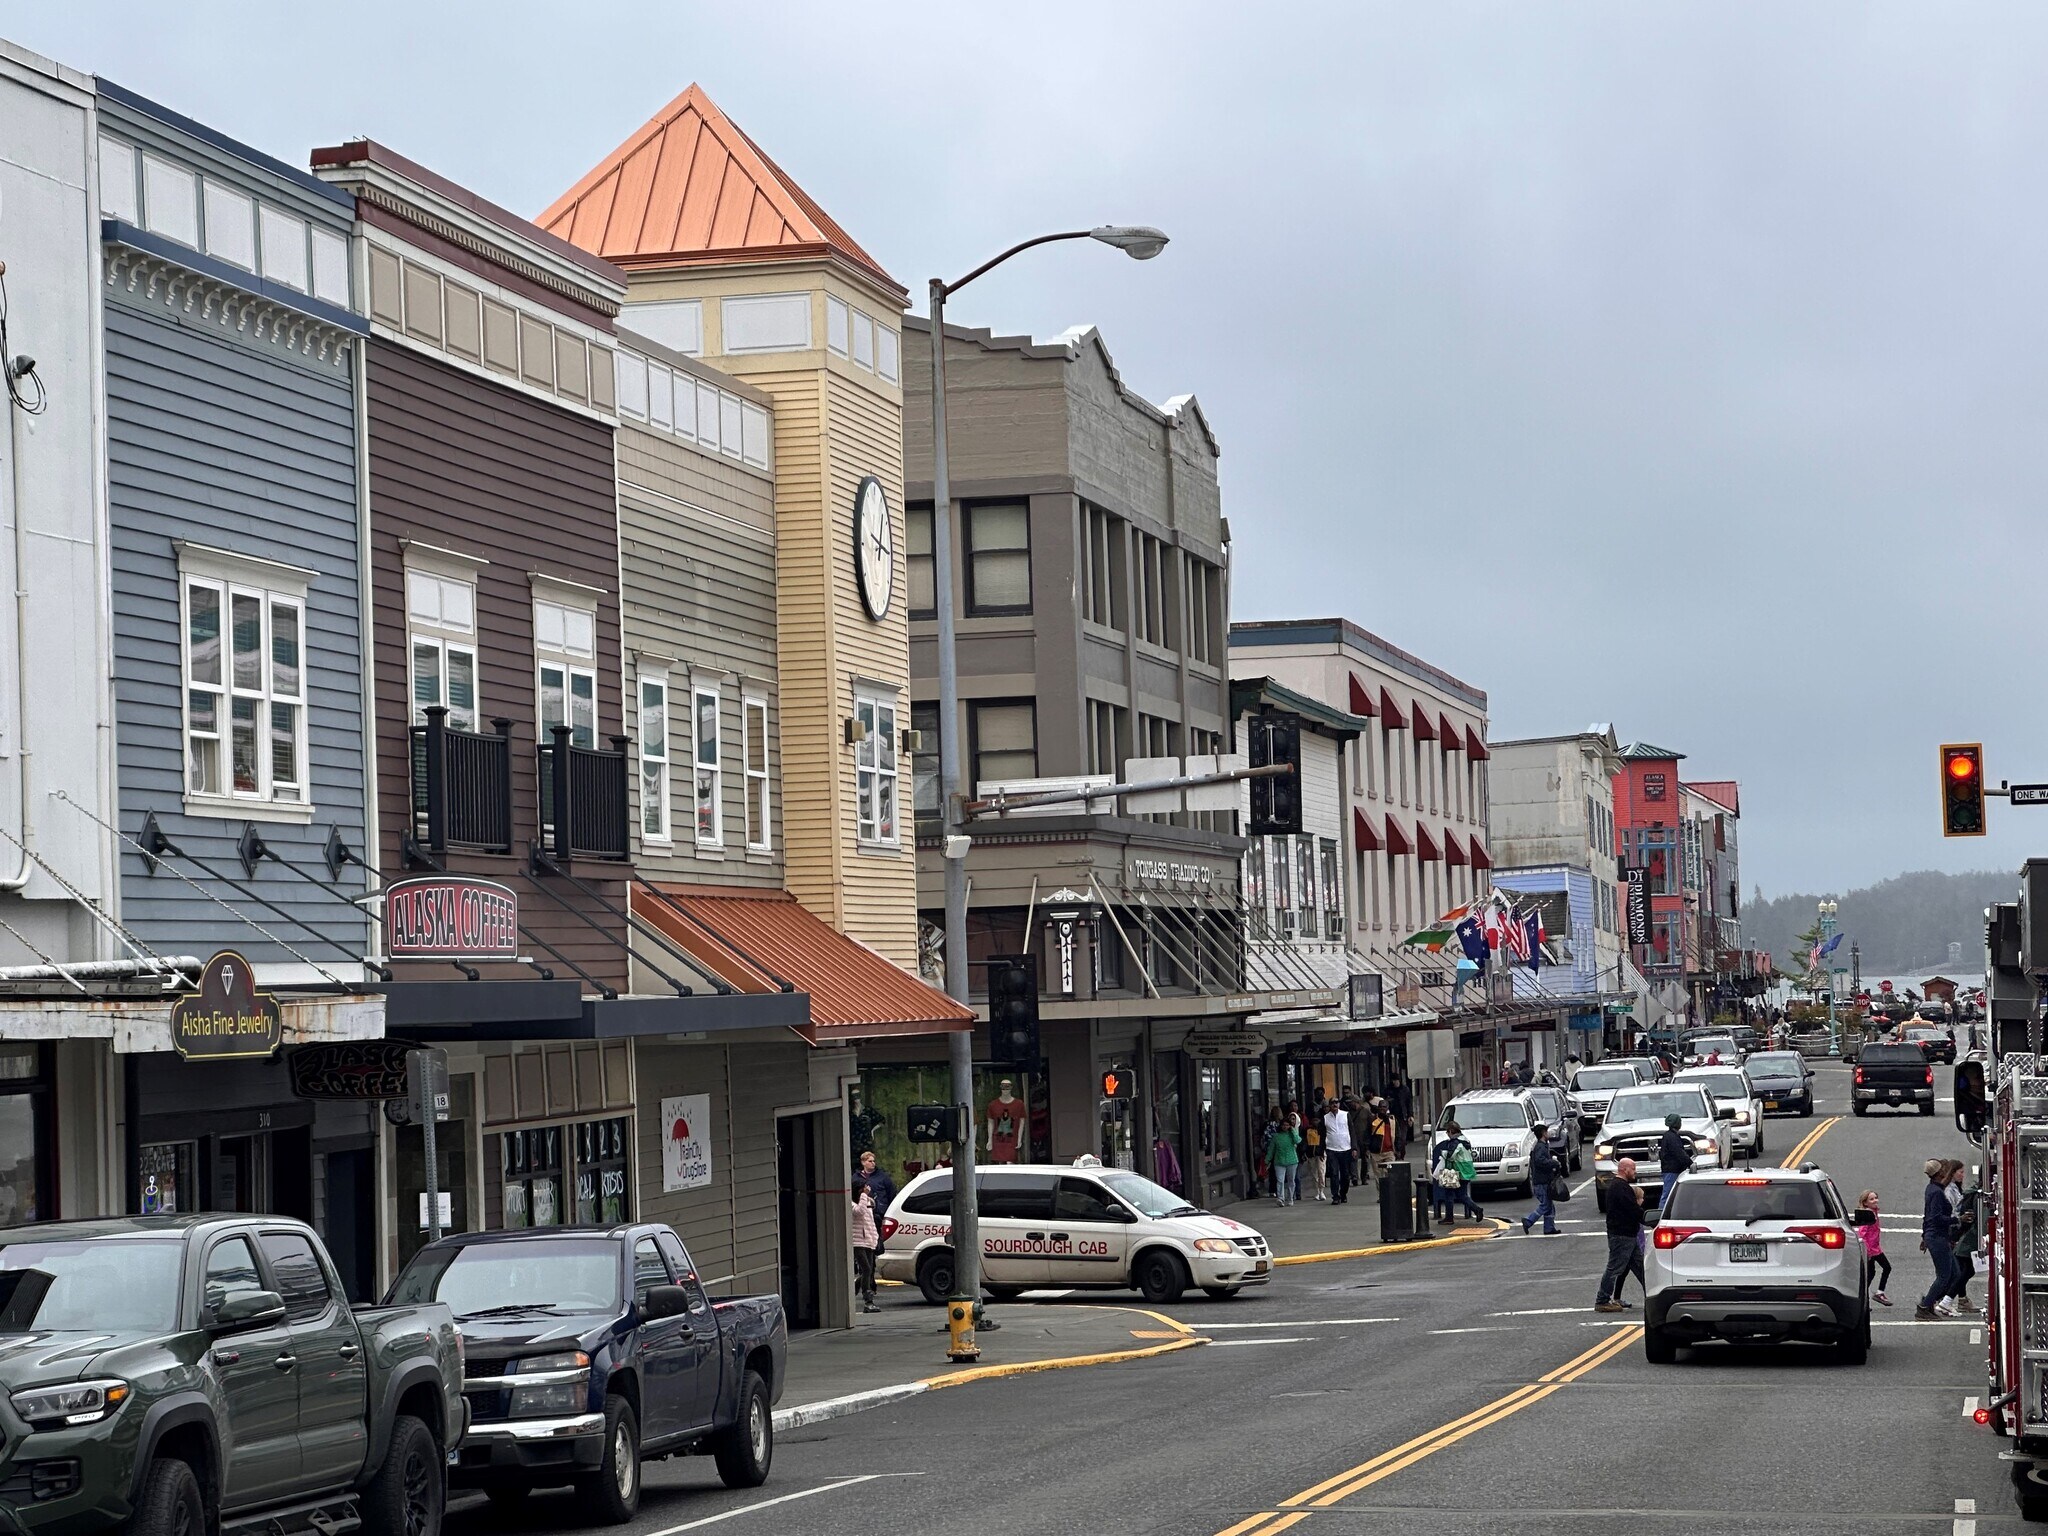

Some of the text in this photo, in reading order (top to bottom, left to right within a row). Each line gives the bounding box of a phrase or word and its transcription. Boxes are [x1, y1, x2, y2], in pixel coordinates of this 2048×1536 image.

[2017, 790, 2034, 799] ONE
[1135, 859, 1167, 880] TONGASS
[1170, 863, 1199, 882] TRADING
[393, 887, 514, 948] ALASKA COFFEE
[1634, 884, 1646, 943] DIAMONDS
[182, 1009, 273, 1040] Aisha Fine Jewelry
[296, 1045, 407, 1075] ALASK
[297, 1071, 408, 1095] COFFE
[436, 1096, 446, 1106] 18
[259, 1112, 270, 1128] 310
[898, 1223, 953, 1236] 225-5544
[985, 1239, 1108, 1255] SOURDOUGH CAB
